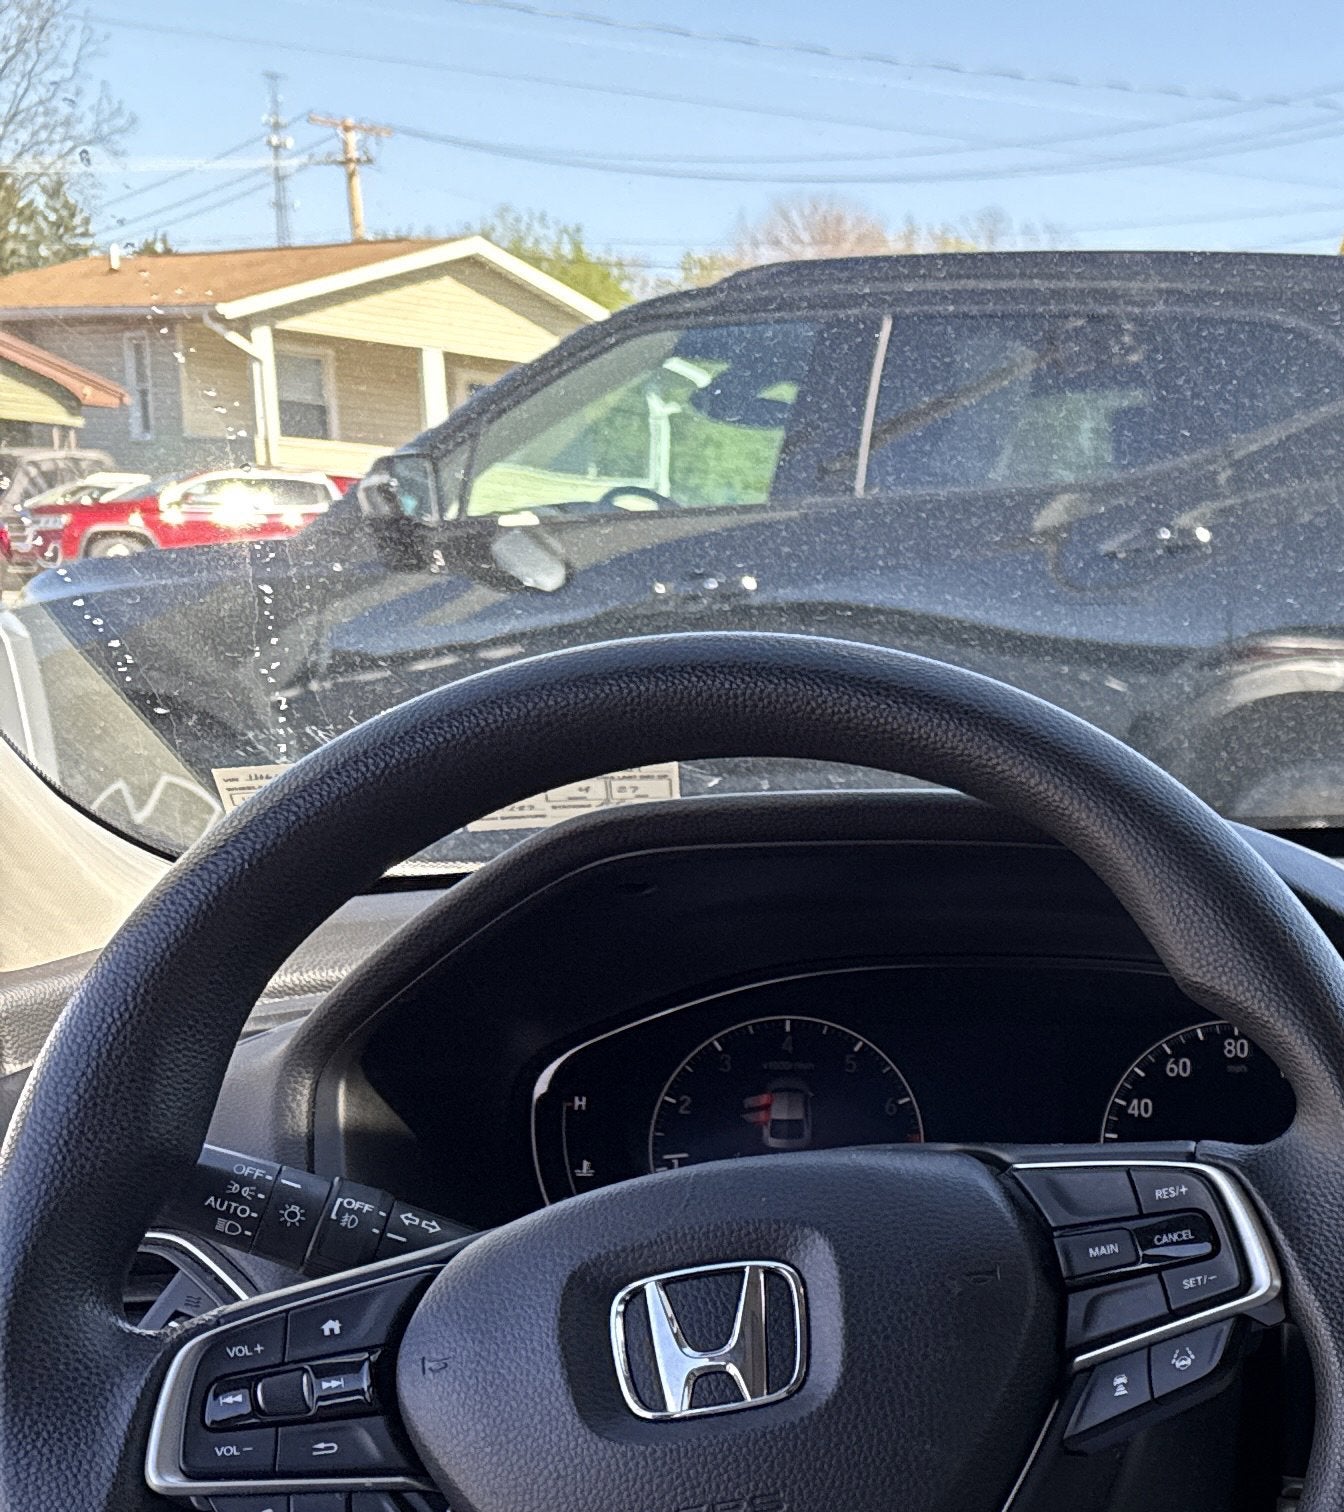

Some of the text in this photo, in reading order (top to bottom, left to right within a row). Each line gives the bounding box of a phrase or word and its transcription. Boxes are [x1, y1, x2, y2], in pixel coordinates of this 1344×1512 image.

[782, 1035, 793, 1054] 4
[1223, 1038, 1249, 1059] 80
[719, 1054, 732, 1073] 3
[845, 1054, 857, 1073] 5
[1165, 1058, 1191, 1078] 60
[574, 1096, 587, 1110] H
[678, 1095, 693, 1115] 2
[884, 1097, 898, 1116] 6
[1128, 1099, 1153, 1119] 40
[232, 1163, 265, 1180] OFF
[1155, 1184, 1189, 1200] RES/+
[204, 1195, 249, 1218] AUTO
[342, 1198, 375, 1214] OFF
[1154, 1229, 1195, 1246] CANCEL
[1088, 1243, 1119, 1258] MAIN
